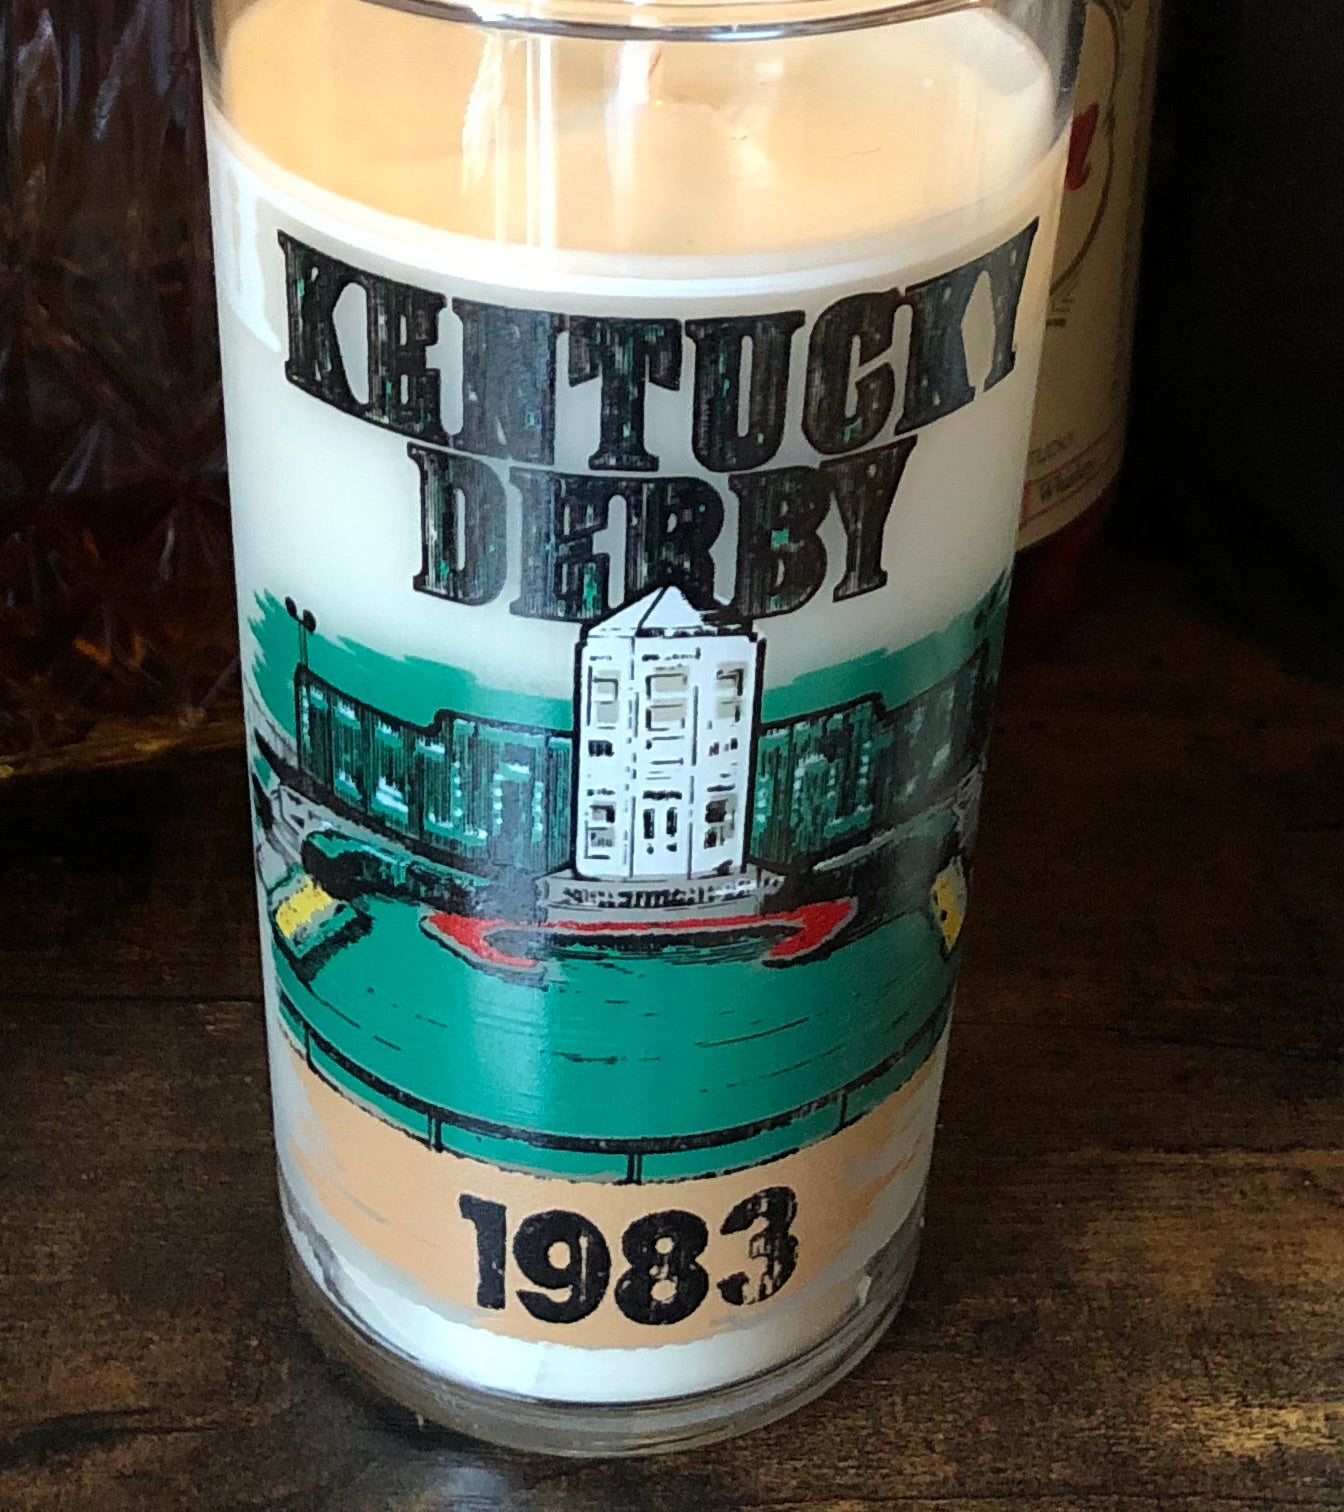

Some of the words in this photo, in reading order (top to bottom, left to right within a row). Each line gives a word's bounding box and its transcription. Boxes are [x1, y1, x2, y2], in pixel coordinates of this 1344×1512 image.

[277, 216, 1040, 473] KENTUCKY
[407, 435, 919, 626] DERBY
[459, 1186, 799, 1324] 1983
